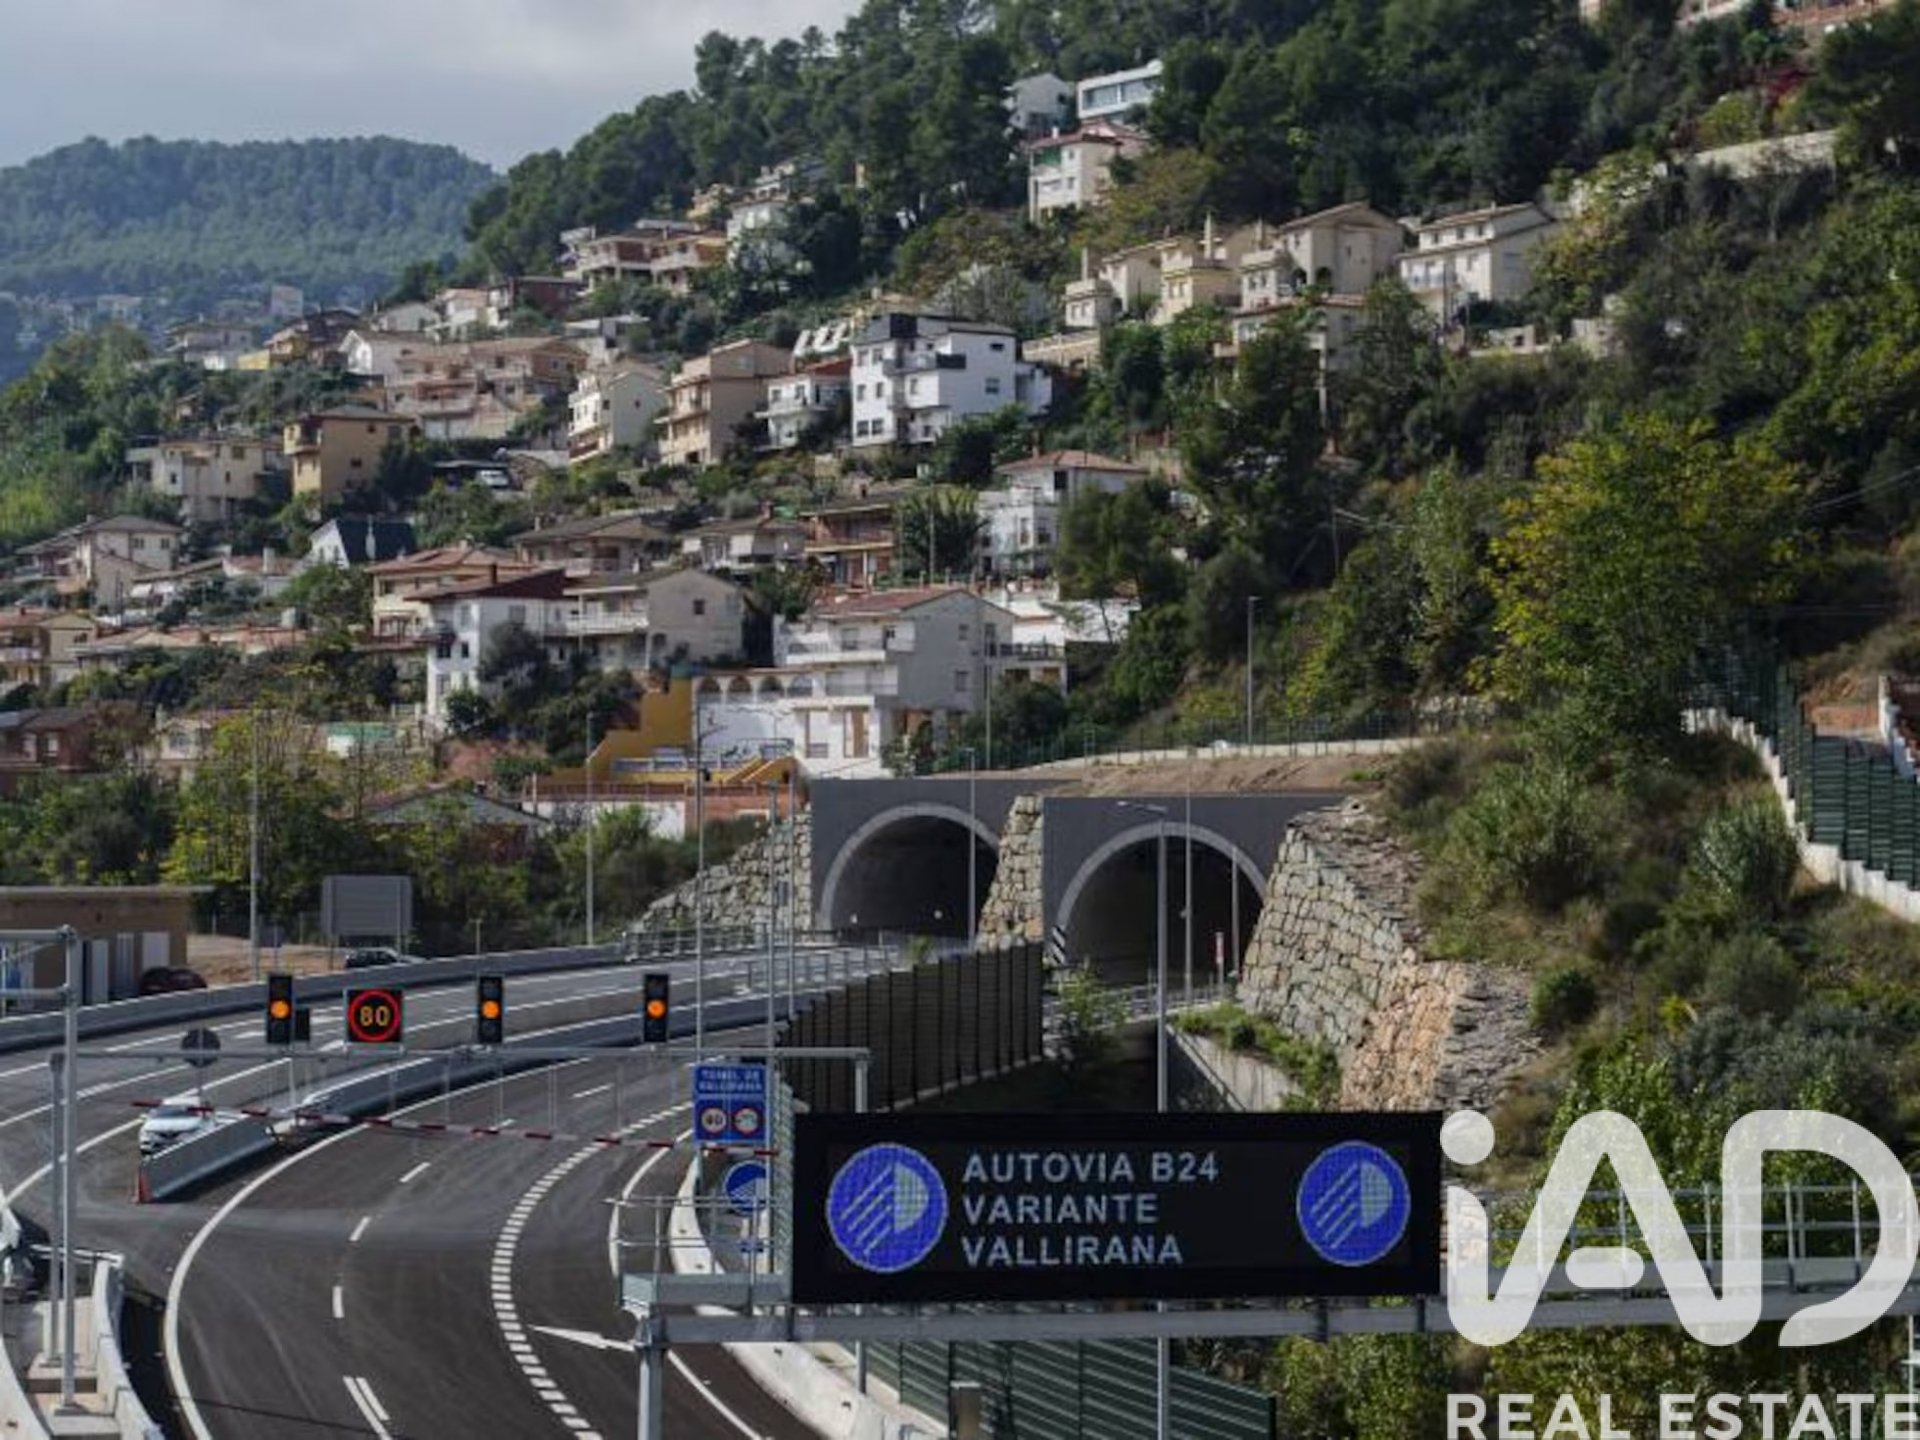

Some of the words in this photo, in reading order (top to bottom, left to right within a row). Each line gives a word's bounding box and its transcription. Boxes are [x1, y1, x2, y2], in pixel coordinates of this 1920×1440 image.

[360, 1006, 390, 1026] 80
[963, 1152, 1135, 1183] AUTOVIA
[1151, 1152, 1219, 1183] B24
[963, 1194, 1158, 1225] VARIANTE
[961, 1234, 1183, 1267] VALLIRANA
